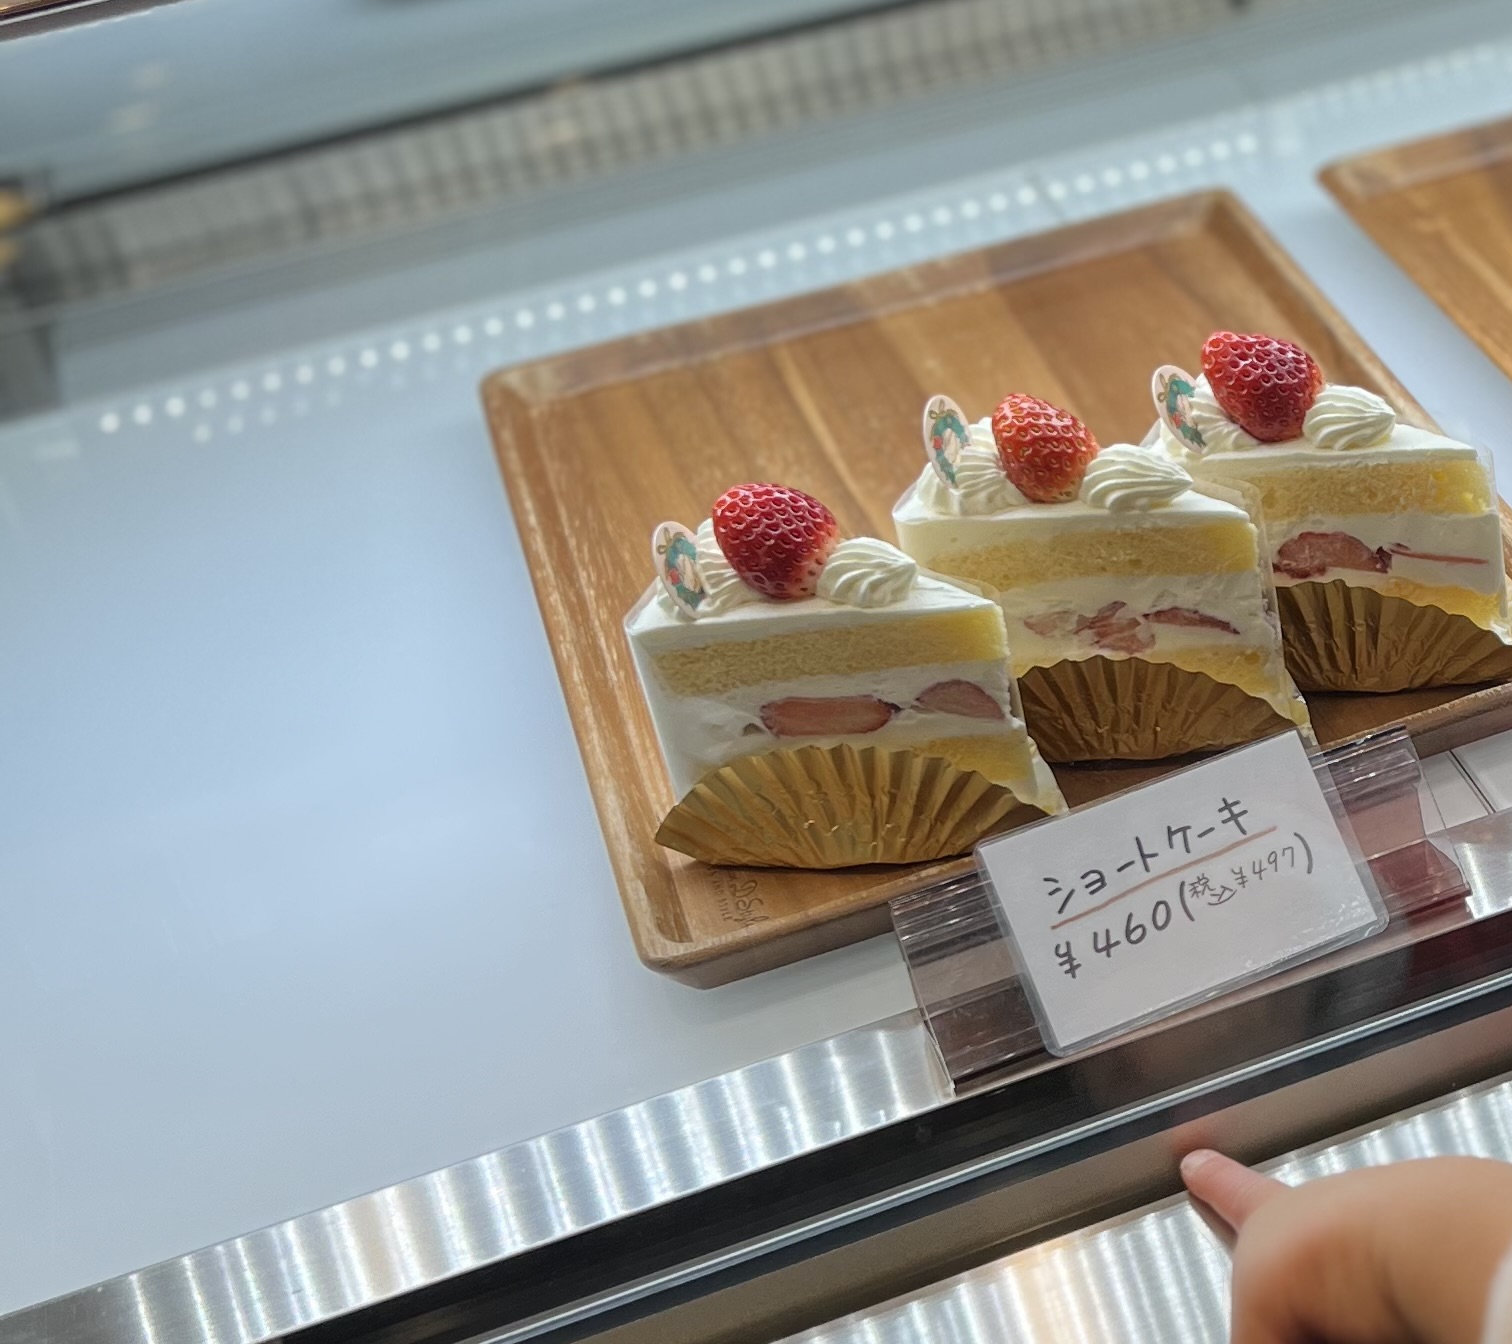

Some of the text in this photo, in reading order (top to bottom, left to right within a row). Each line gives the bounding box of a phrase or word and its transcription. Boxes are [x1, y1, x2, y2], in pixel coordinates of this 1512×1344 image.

[1043, 798, 1249, 915] ショートケーキ
